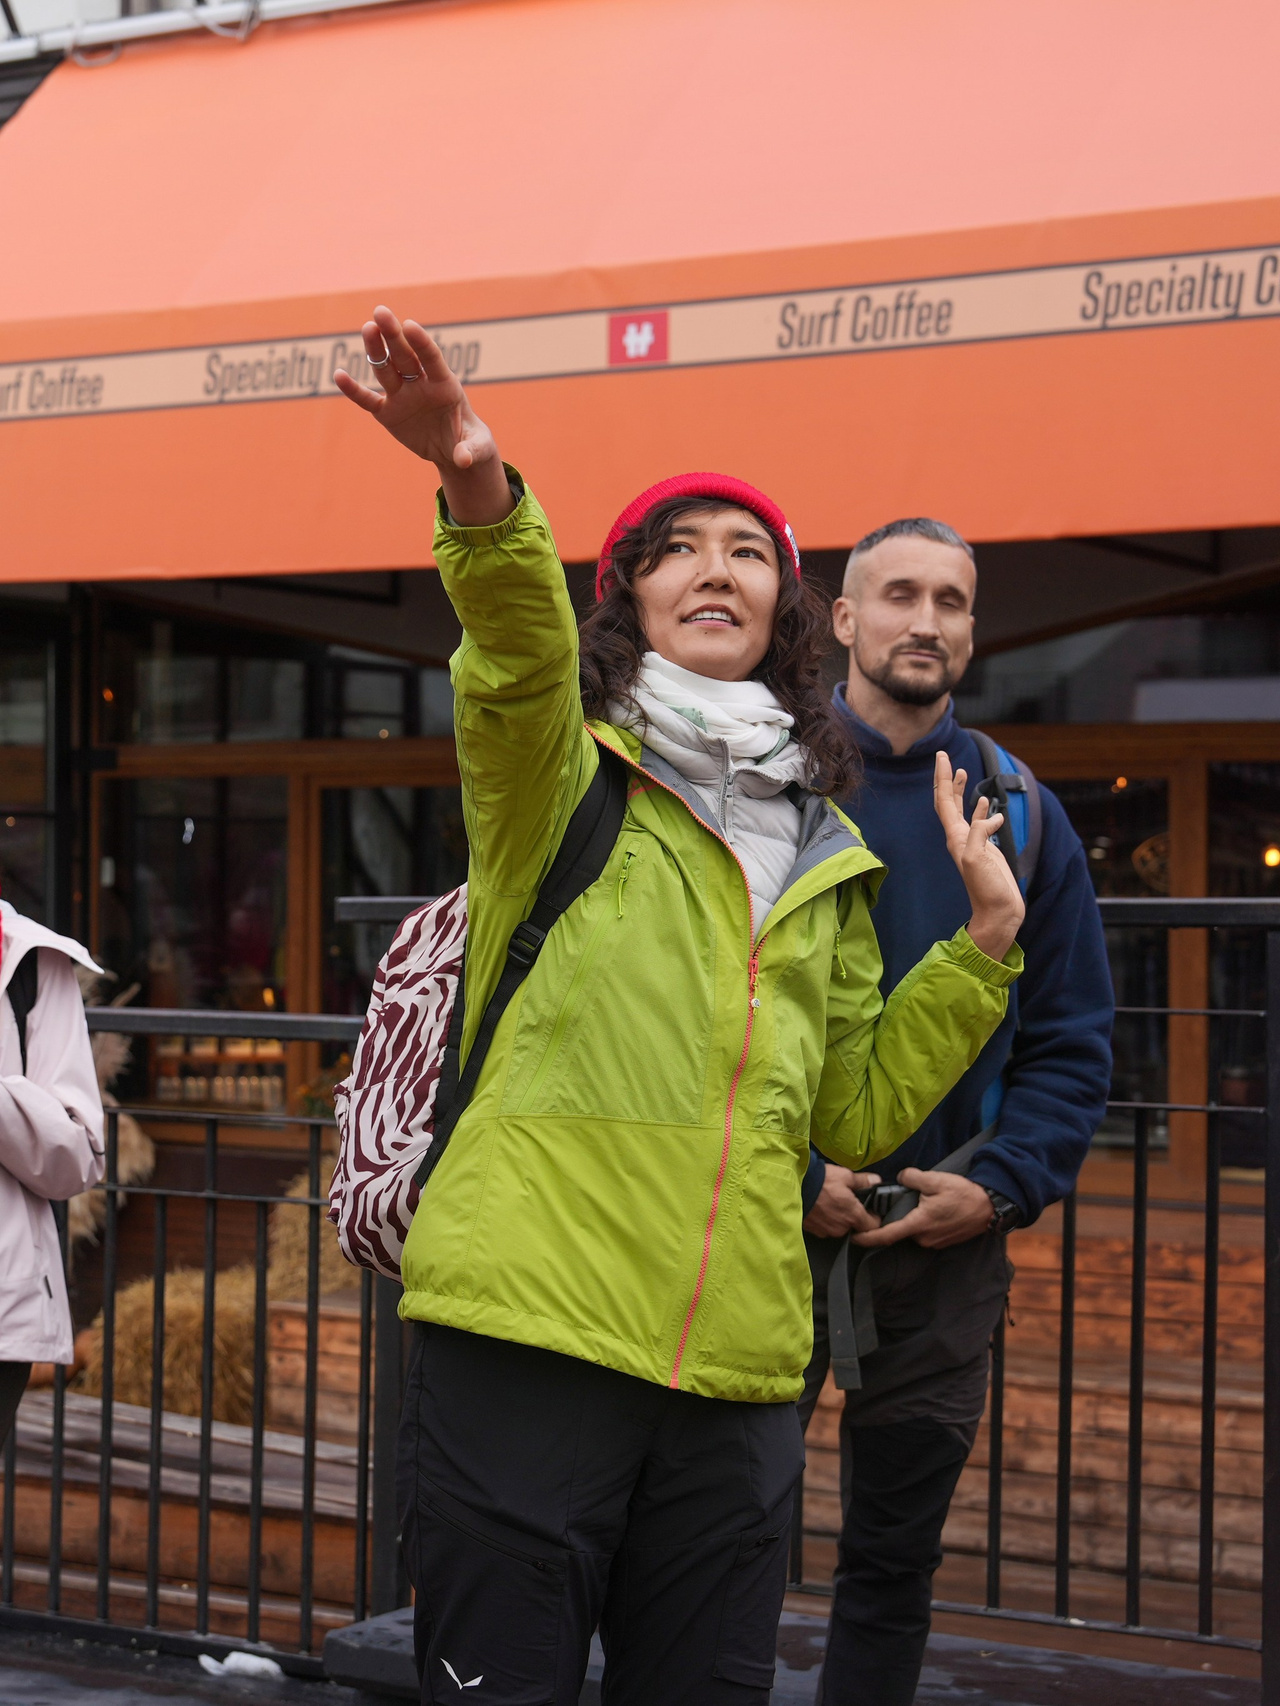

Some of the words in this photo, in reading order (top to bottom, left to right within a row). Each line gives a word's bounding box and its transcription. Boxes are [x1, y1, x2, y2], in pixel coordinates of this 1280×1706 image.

[777, 297, 843, 350] Surf
[850, 289, 953, 343] Coffee
[1080, 260, 1245, 329] Specialty
[27, 366, 104, 411] Coffee
[204, 345, 324, 403] Specialty
